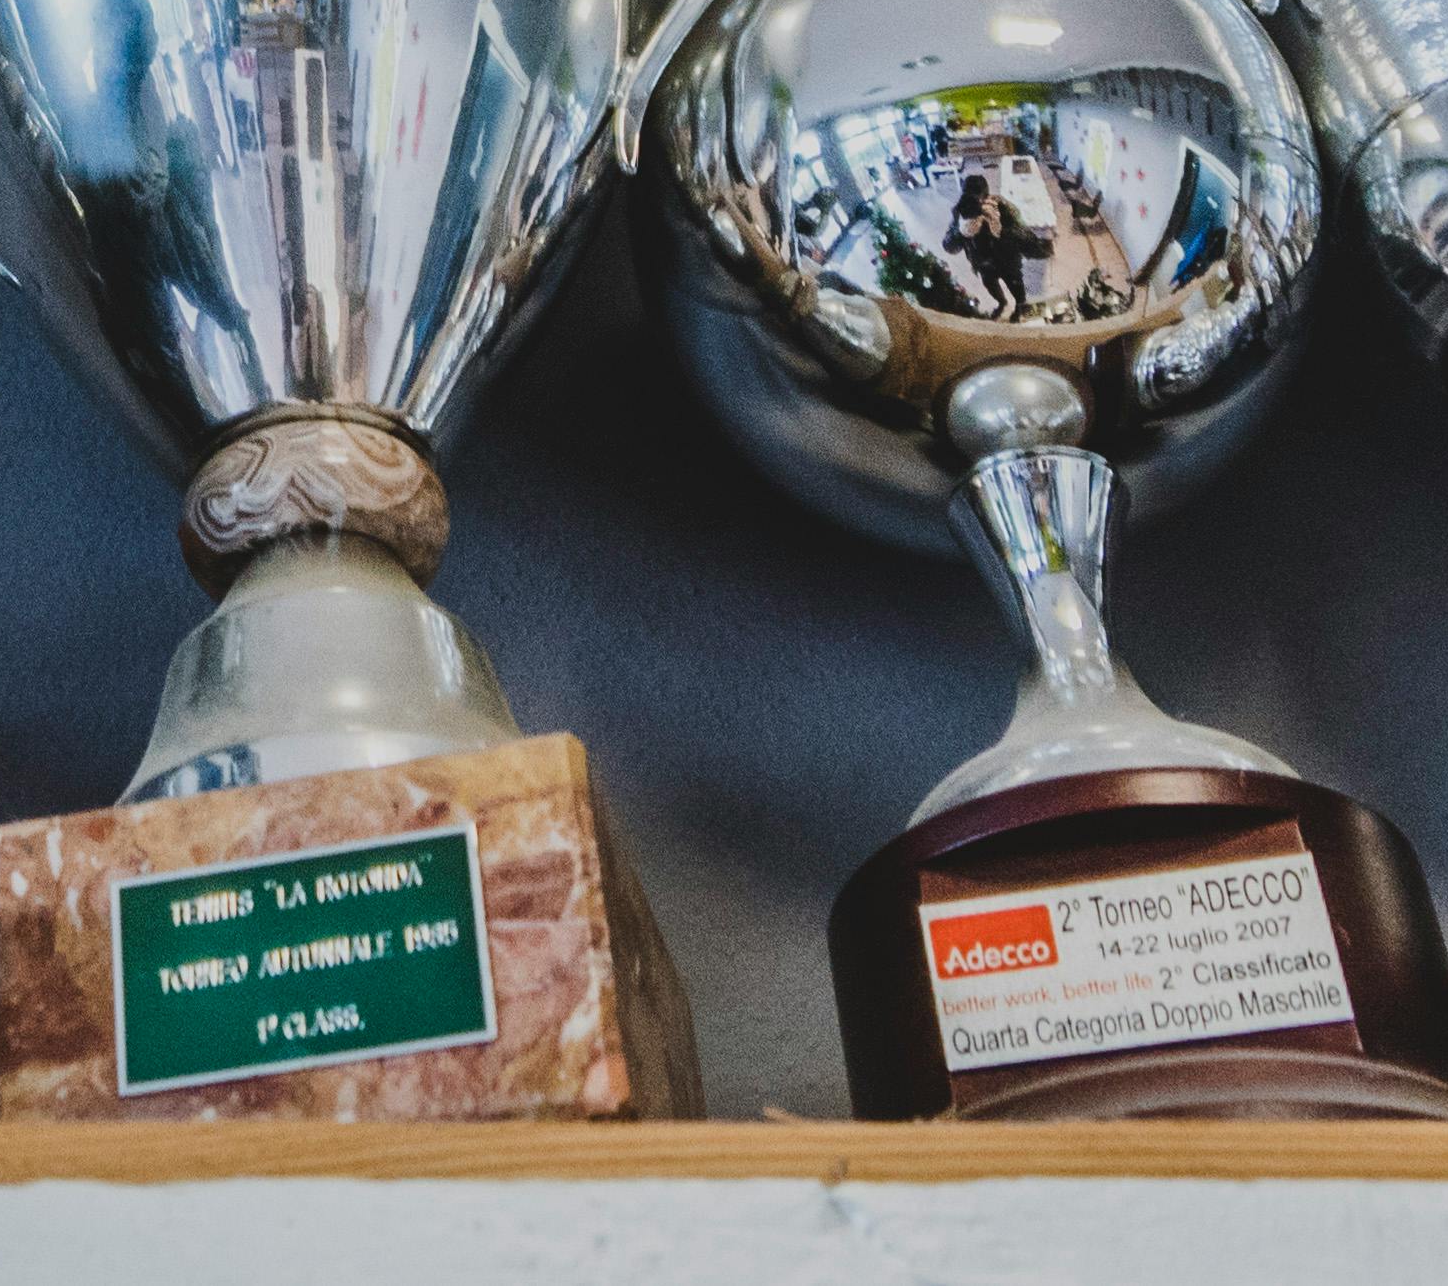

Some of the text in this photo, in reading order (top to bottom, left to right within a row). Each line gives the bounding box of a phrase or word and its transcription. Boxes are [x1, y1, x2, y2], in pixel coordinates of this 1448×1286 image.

[170, 889, 254, 928] TENNIS
[1090, 893, 1173, 928] Torneo
[943, 938, 1051, 976] Adecco
[1097, 915, 1292, 960] 14-22 luglio 2007
[158, 954, 249, 995] TORNEO
[1192, 949, 1332, 986] Classificato
[942, 972, 1153, 1017] better work, better life
[952, 983, 1342, 1056] Quarta Categoria Doppio Maschile
